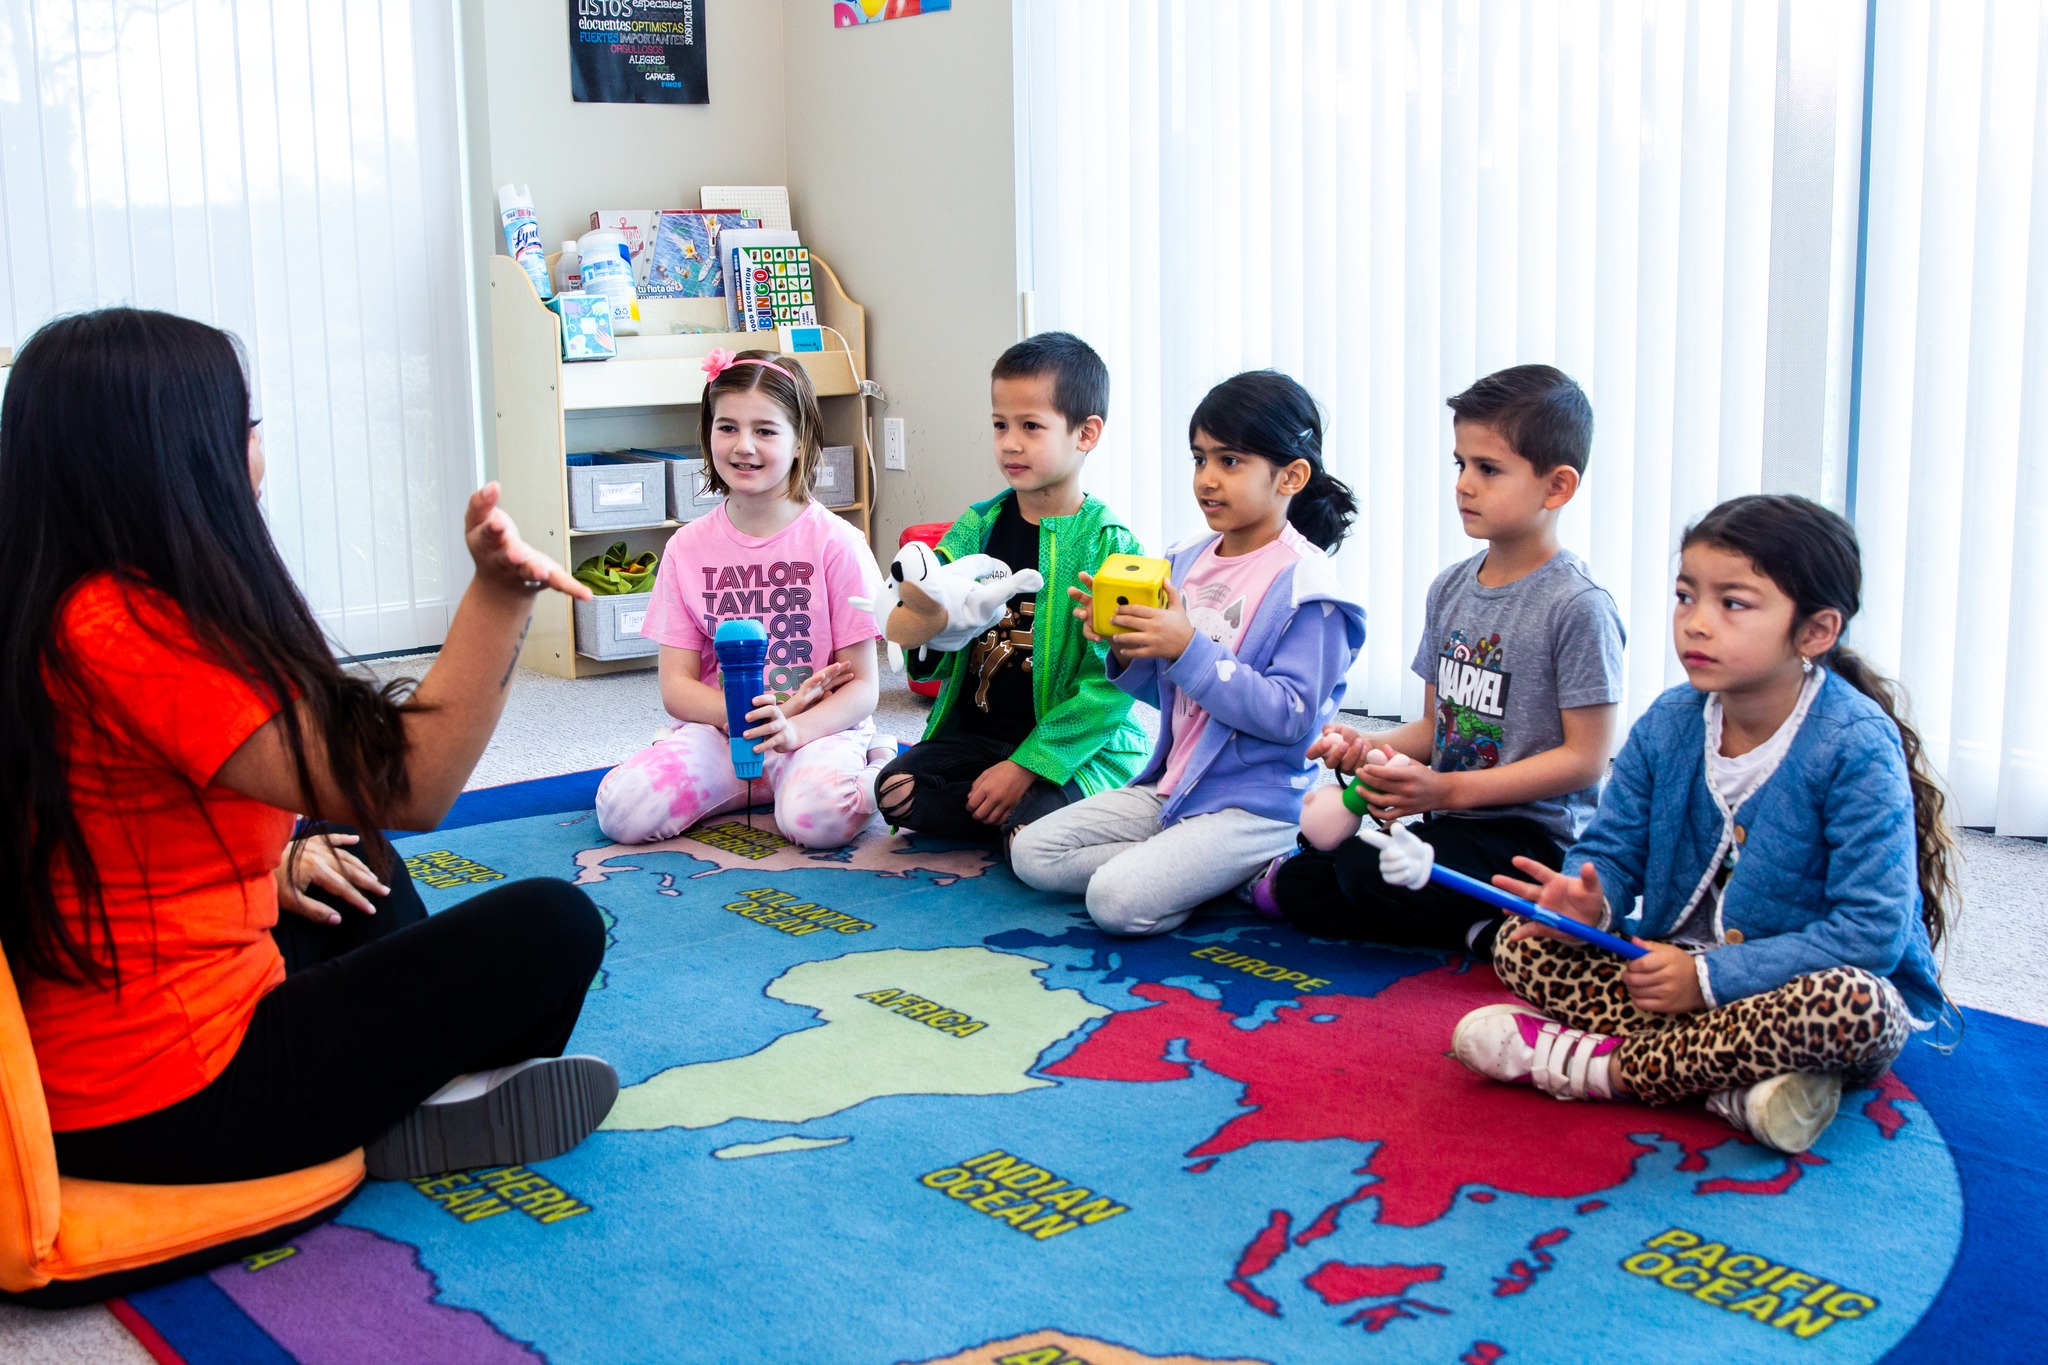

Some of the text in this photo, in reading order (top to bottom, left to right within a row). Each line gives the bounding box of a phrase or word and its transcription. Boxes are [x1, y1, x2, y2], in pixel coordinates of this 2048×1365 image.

[578, 0, 633, 17] LISTOS
[578, 16, 685, 33] elocuentes OPTIMISTAS
[632, 0, 683, 11] especiales
[684, 0, 693, 45] PRECIOSOS
[579, 31, 685, 45] FUERTES IMPORTANTES
[610, 44, 664, 54] ORGULLOSOS
[628, 55, 666, 65] ALEGRES
[645, 73, 676, 81] CAPACES
[745, 267, 753, 312] RECOGNITION
[752, 268, 774, 331] BINGO
[702, 561, 814, 591] TAYLOR
[702, 587, 812, 616] TAYLOR
[1438, 656, 1503, 717] MARVEL
[684, 828, 778, 860] AMERICA
[416, 849, 507, 883] PACIFIC
[722, 900, 824, 936] OCEAN
[736, 887, 877, 935] ATLANTIC
[1190, 945, 1333, 992] EUROPE
[854, 988, 989, 1038] AFRICA
[407, 1173, 512, 1224] EAN
[916, 1166, 1080, 1242] OCEAN
[960, 1149, 1131, 1226] INDIAN
[1642, 1226, 1882, 1320] PACIFIC
[1618, 1251, 1835, 1339] OCEAN
